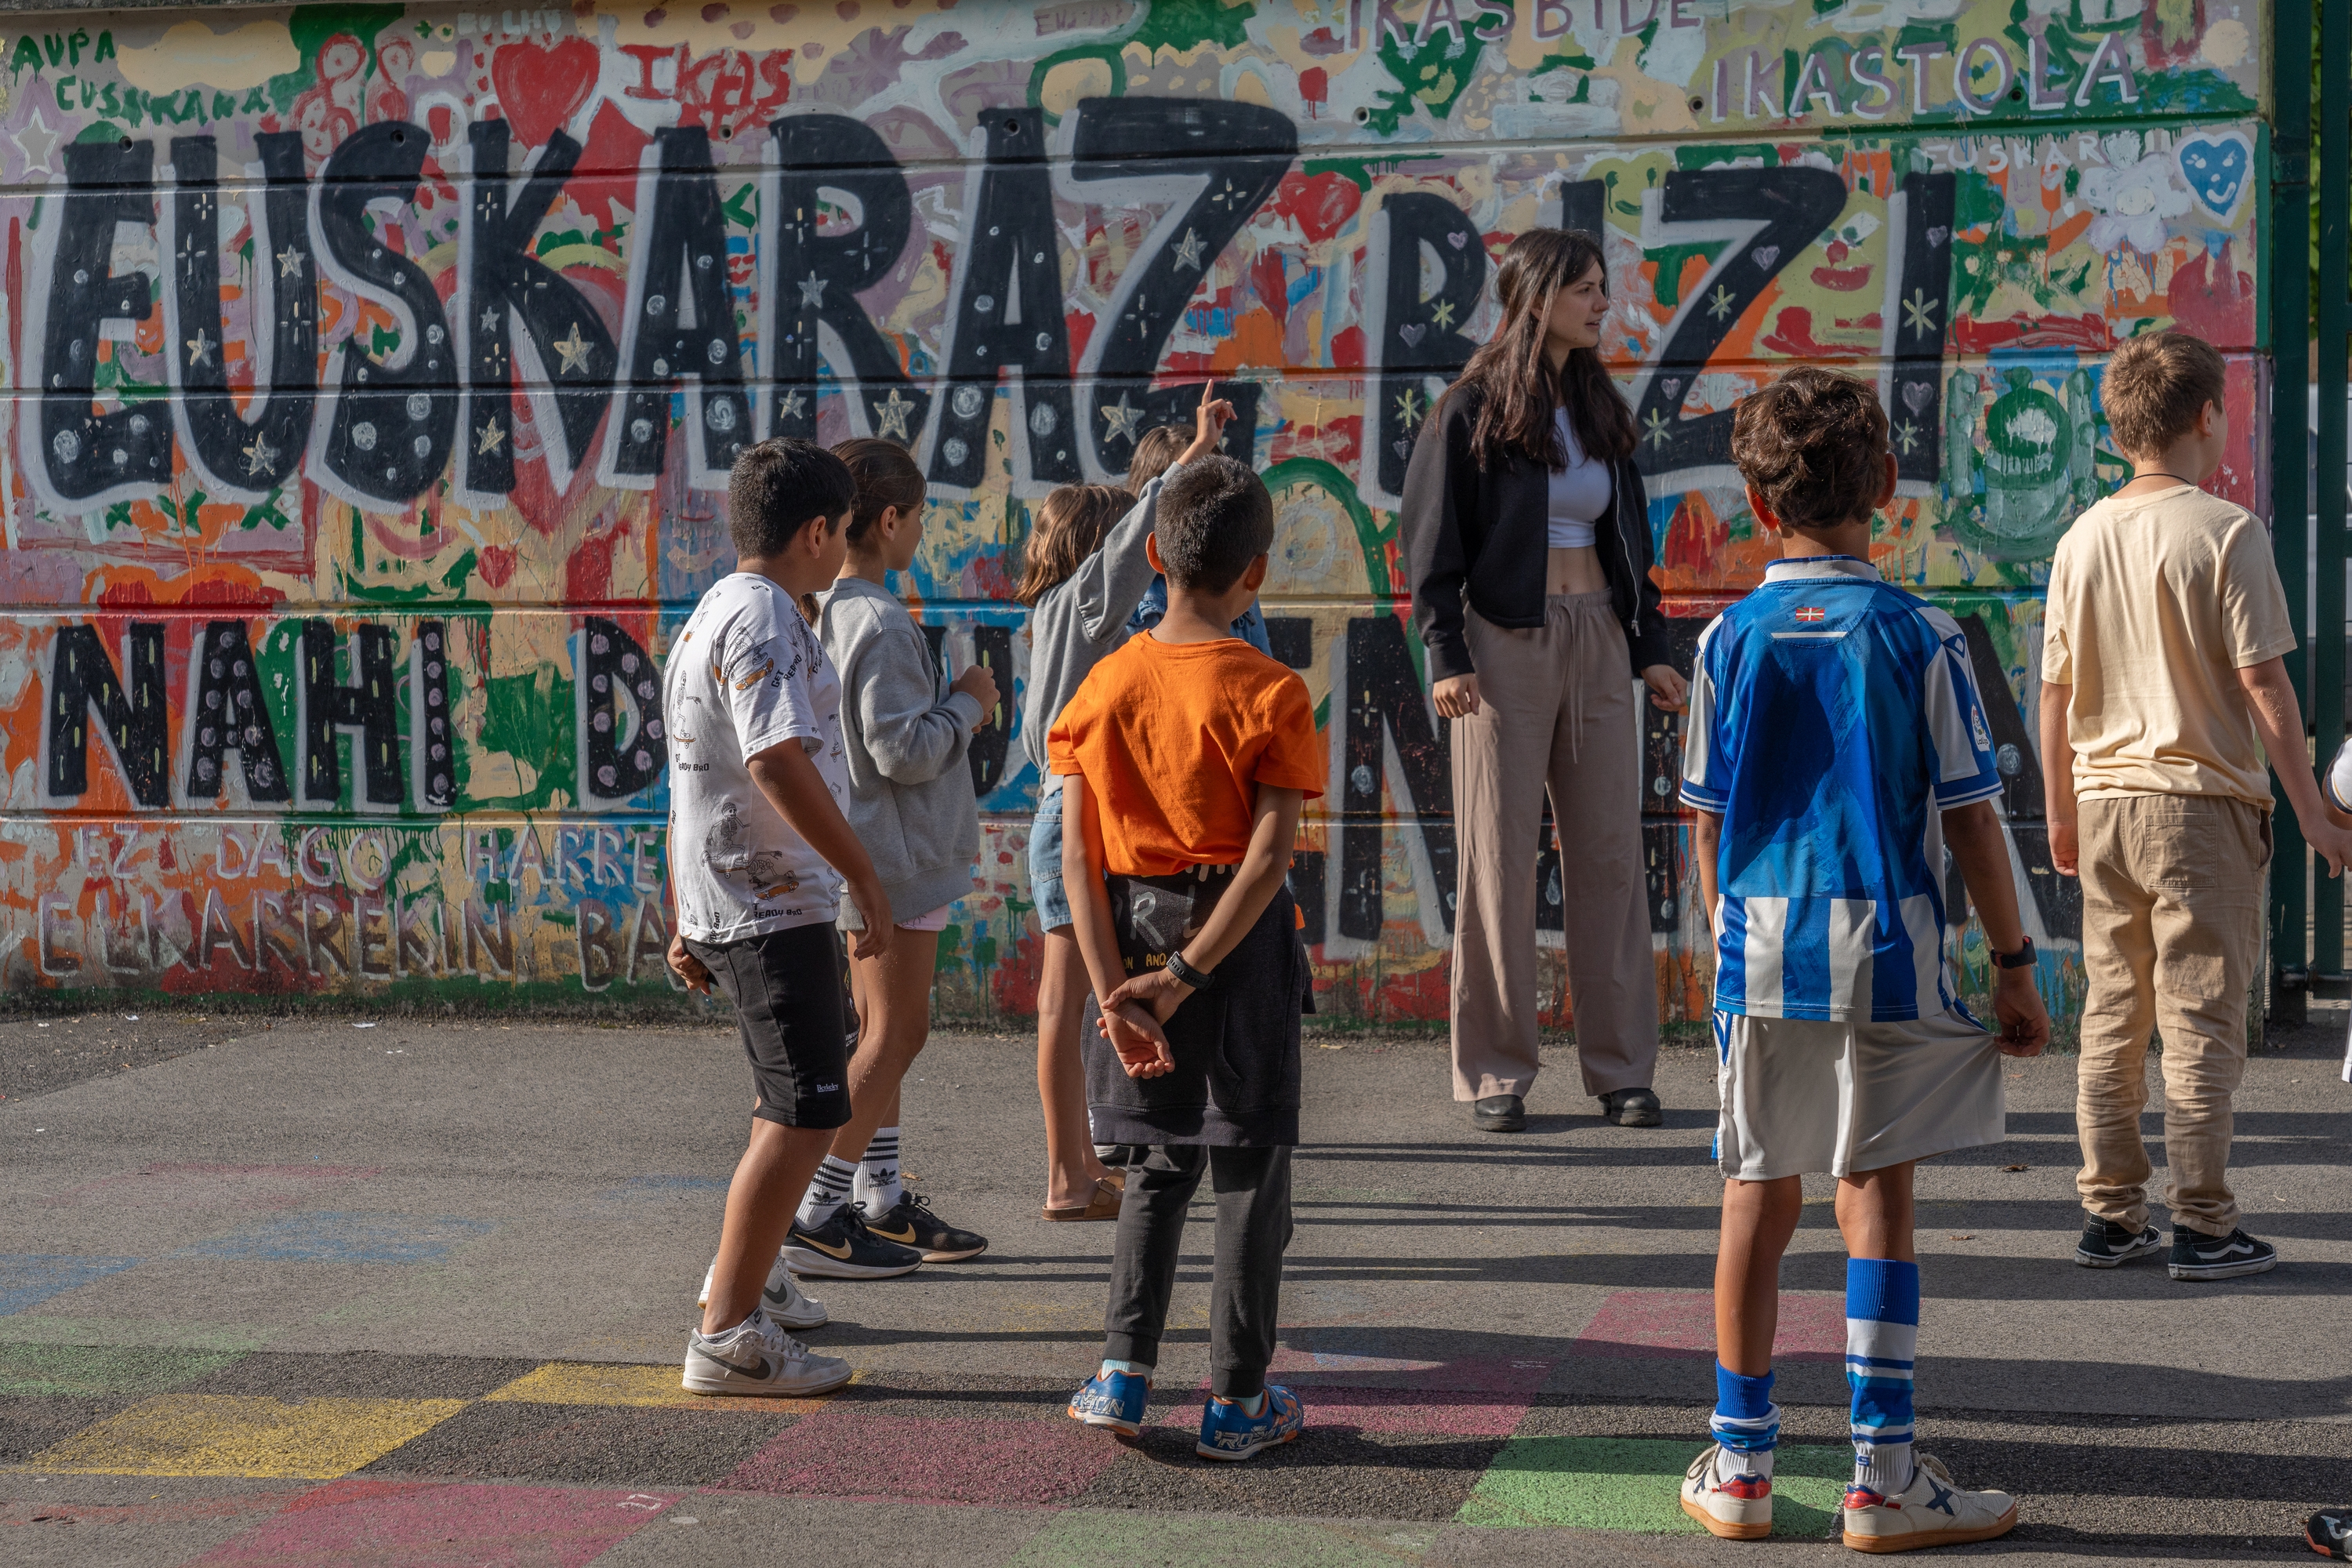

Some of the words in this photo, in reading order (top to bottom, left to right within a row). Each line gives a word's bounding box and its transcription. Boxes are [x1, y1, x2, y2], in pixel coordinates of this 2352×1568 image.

[9, 27, 116, 77] AUPA
[1711, 31, 2140, 123] IKASTOLA
[19, 97, 1298, 516] EUSKARAZ
[771, 669, 785, 688] GET
[39, 616, 458, 811] NAHI
[693, 763, 710, 772] BRO
[78, 822, 142, 879] EZ
[210, 825, 391, 891] DAGO
[38, 887, 513, 980] ELKARREKIN
[786, 908, 803, 916] BRO
